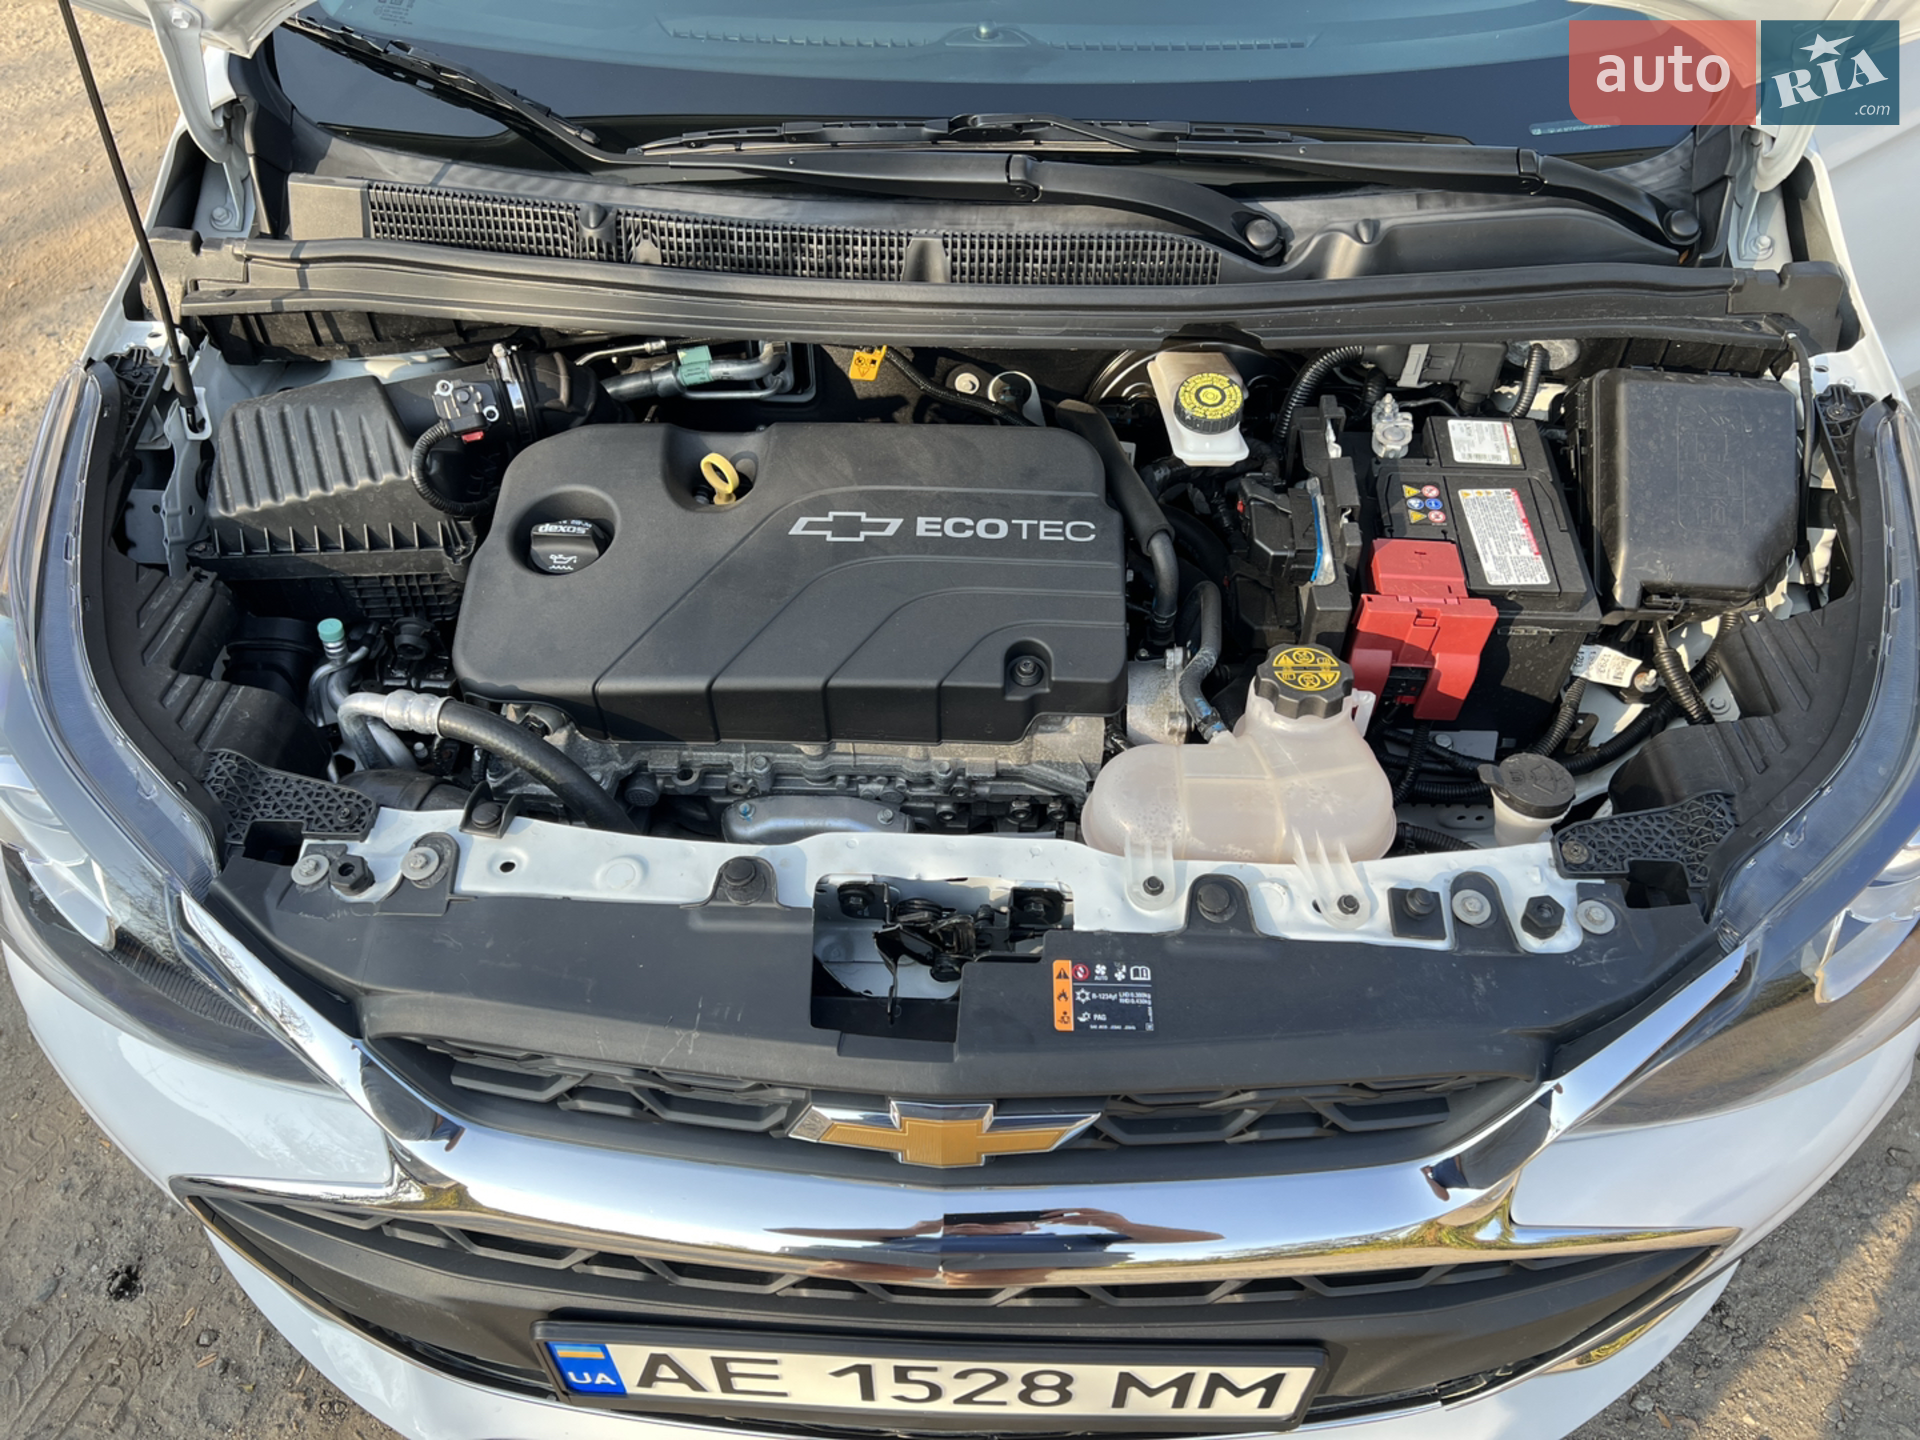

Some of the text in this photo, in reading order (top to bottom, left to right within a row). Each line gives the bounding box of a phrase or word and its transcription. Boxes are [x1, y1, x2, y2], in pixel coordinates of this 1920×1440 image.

[538, 523, 587, 534] dexos
[916, 516, 1097, 542] ECOTEC
[566, 1371, 617, 1387] UA
[636, 1353, 1287, 1409] AE 1528 MM
